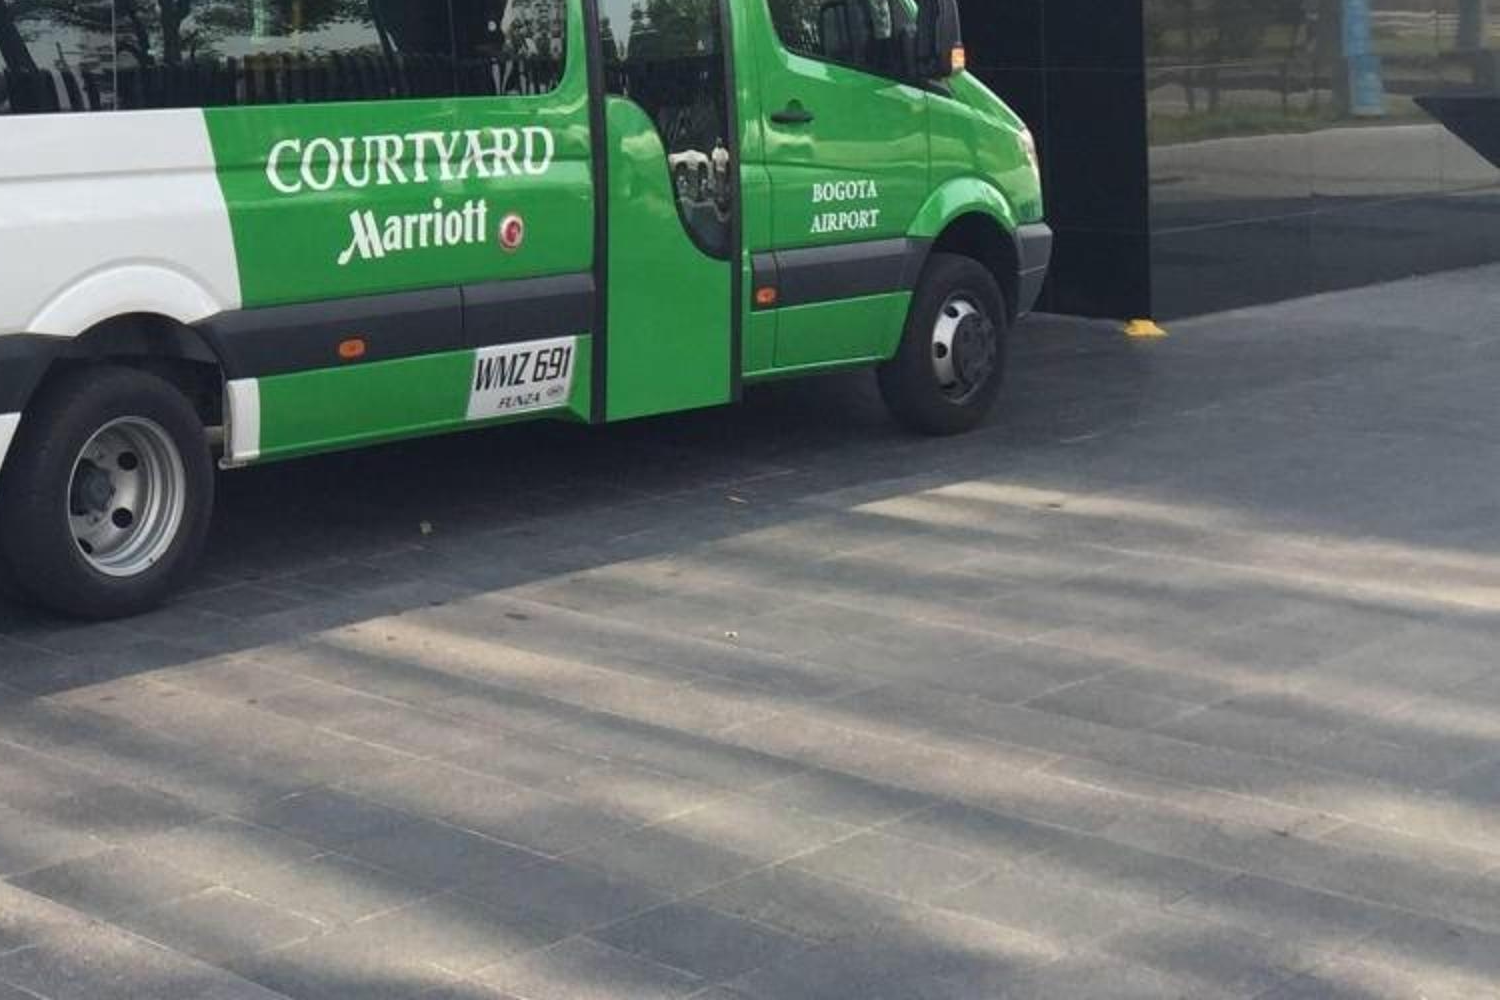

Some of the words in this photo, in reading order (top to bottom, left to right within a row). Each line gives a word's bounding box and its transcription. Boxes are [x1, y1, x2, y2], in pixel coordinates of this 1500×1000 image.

[265, 126, 555, 194] COURTYARD
[812, 179, 879, 204] BOGOTA
[337, 197, 488, 265] Marriott
[810, 208, 881, 234] AIRPORT
[475, 351, 532, 391] WMZ
[532, 345, 572, 382] 691
